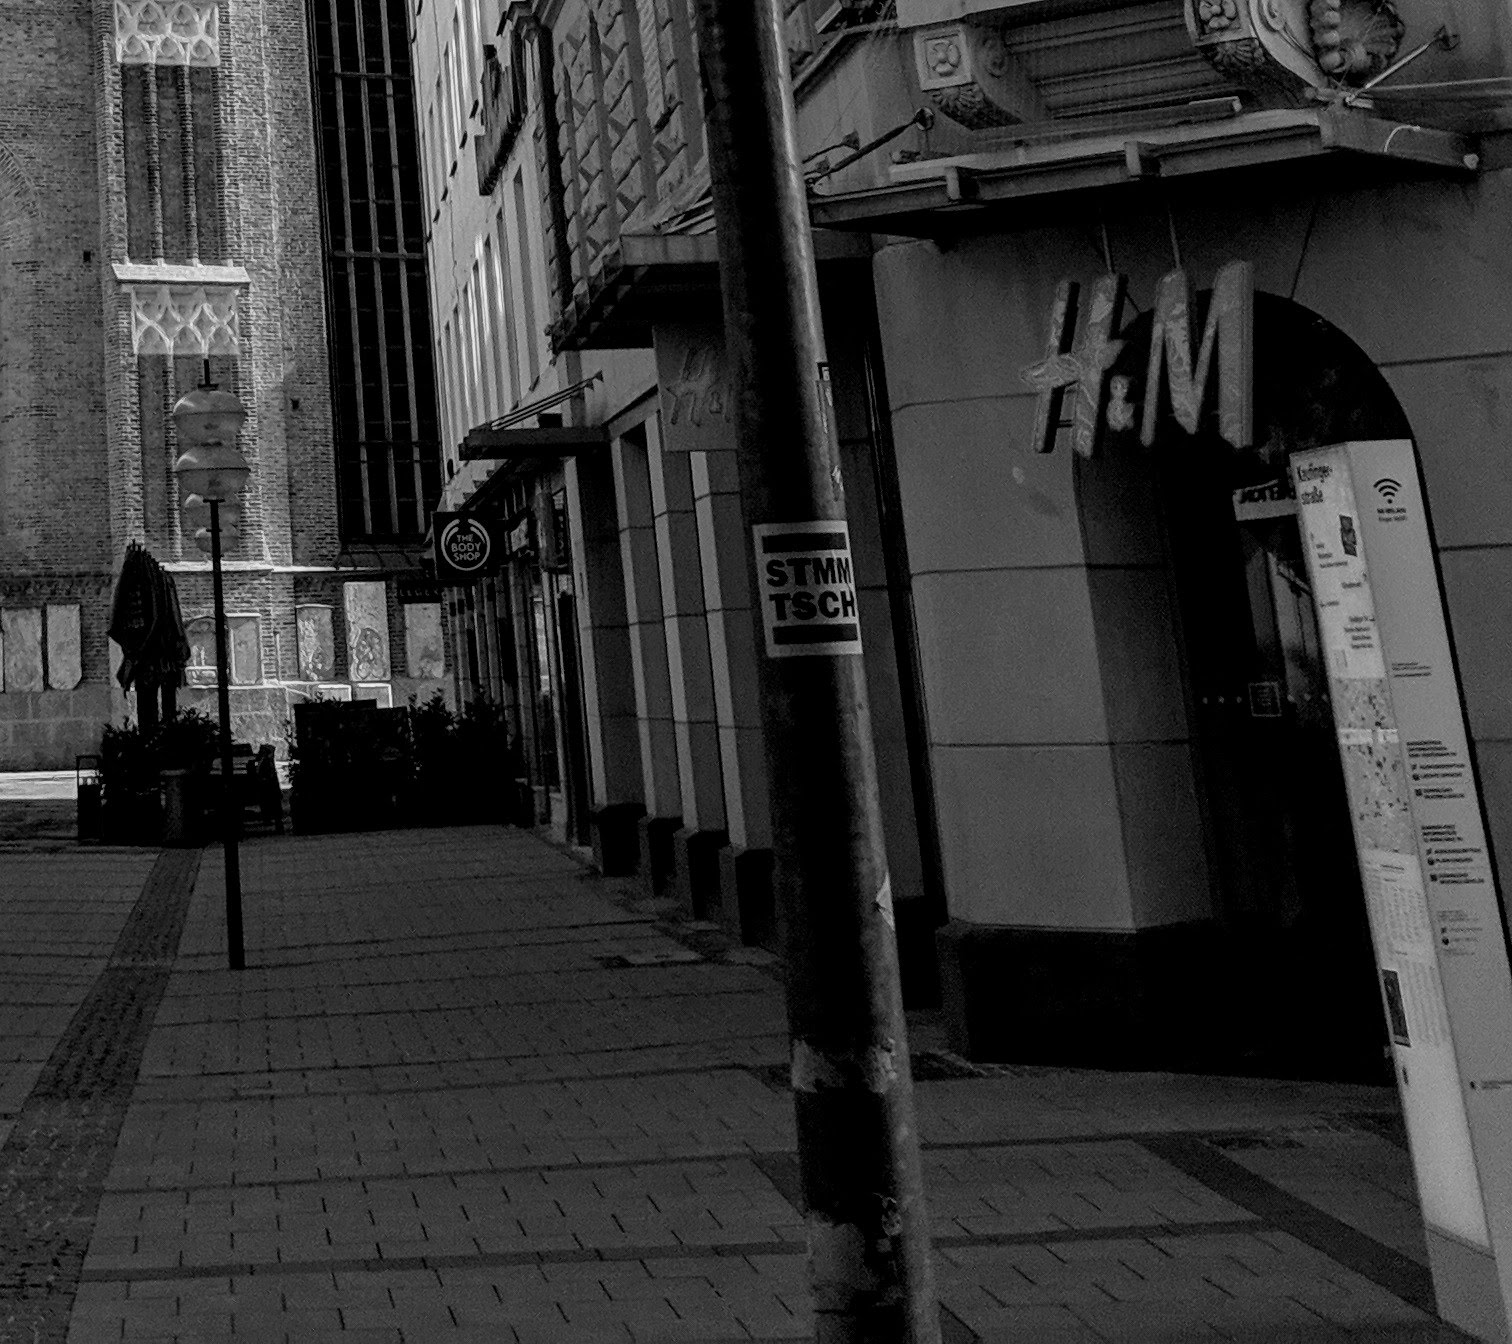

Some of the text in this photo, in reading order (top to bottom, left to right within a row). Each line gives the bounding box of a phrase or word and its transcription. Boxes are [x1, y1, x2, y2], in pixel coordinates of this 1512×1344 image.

[1020, 259, 1253, 460] H&M
[451, 542, 481, 552] BODY
[457, 533, 474, 543] THE
[454, 551, 481, 562] SHOP
[766, 557, 852, 587] STMM
[769, 591, 856, 621] TSCH
